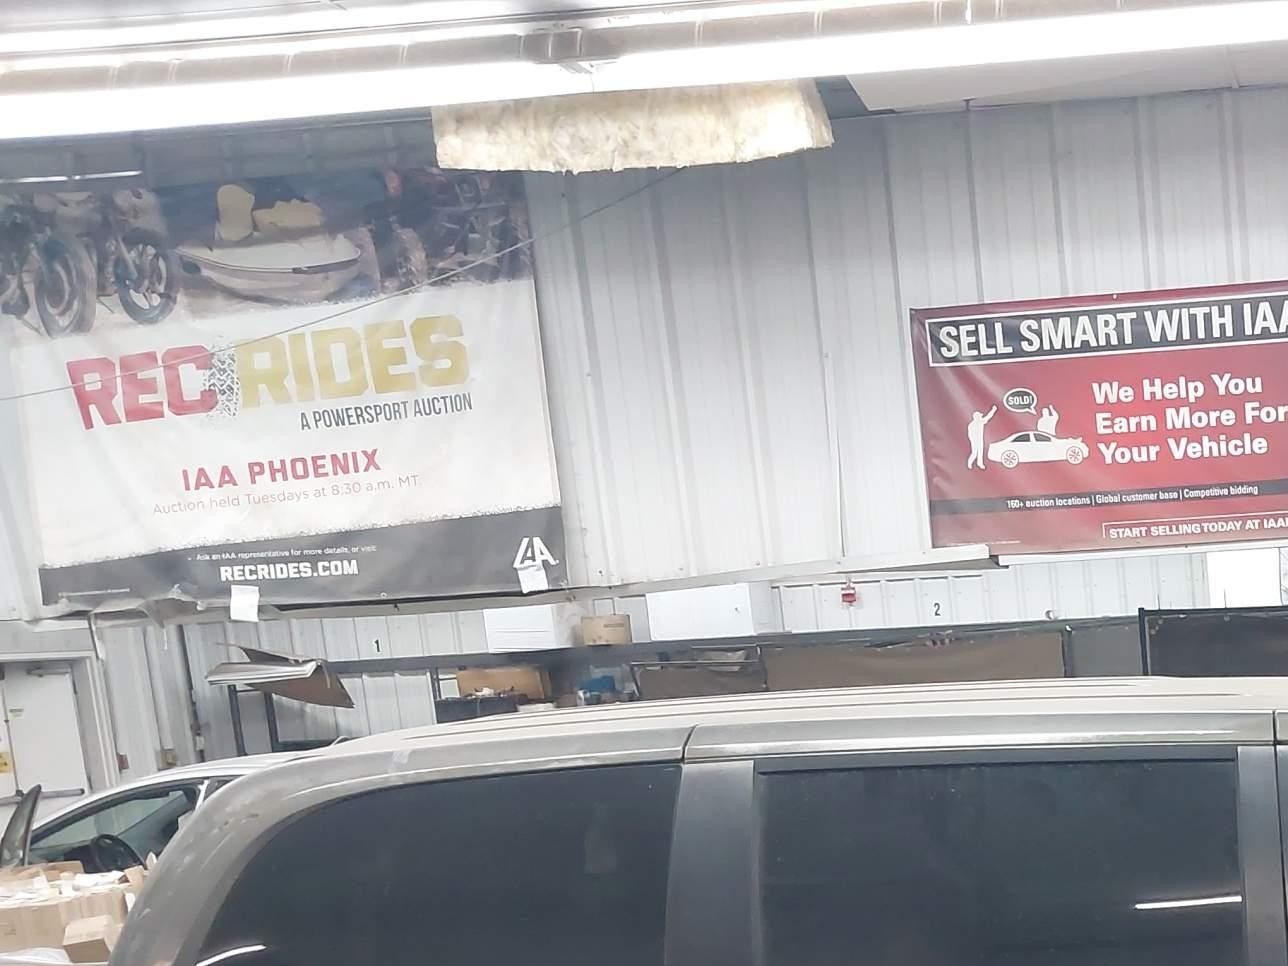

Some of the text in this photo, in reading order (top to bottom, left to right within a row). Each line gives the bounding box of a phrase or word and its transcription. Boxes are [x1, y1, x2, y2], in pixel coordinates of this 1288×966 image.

[939, 321, 1013, 358] SELL
[1019, 311, 1137, 353] SMART
[1143, 304, 1234, 343] WITH
[1008, 395, 1033, 405] SOLD!
[1092, 372, 1263, 404] We Help You
[300, 392, 473, 430] A POWERSPORT AUCTION
[1095, 401, 1288, 435] Earn More For
[1097, 432, 1268, 465] Your Vehicle
[182, 449, 381, 491] IAA PHOENIX
[152, 499, 205, 515] Auction
[209, 495, 240, 508] held
[245, 489, 309, 505] Tuesdays
[313, 487, 328, 498] at
[331, 482, 362, 496] 8:30
[398, 474, 419, 488] MT
[1025, 497, 1055, 508] auction
[1056, 495, 1091, 506] locations
[1096, 493, 1121, 504] Global
[1122, 492, 1158, 502] customer
[1159, 490, 1178, 500] base
[1183, 486, 1229, 499] Competitive
[1229, 484, 1259, 496] bidding
[1109, 526, 1148, 540] START
[1150, 523, 1200, 537] SELLING
[1201, 520, 1243, 534] TODAY
[1245, 519, 1261, 530] AT
[219, 559, 359, 582] RECRIDES.COM
[933, 602, 941, 616] 2
[374, 639, 381, 653] 1
